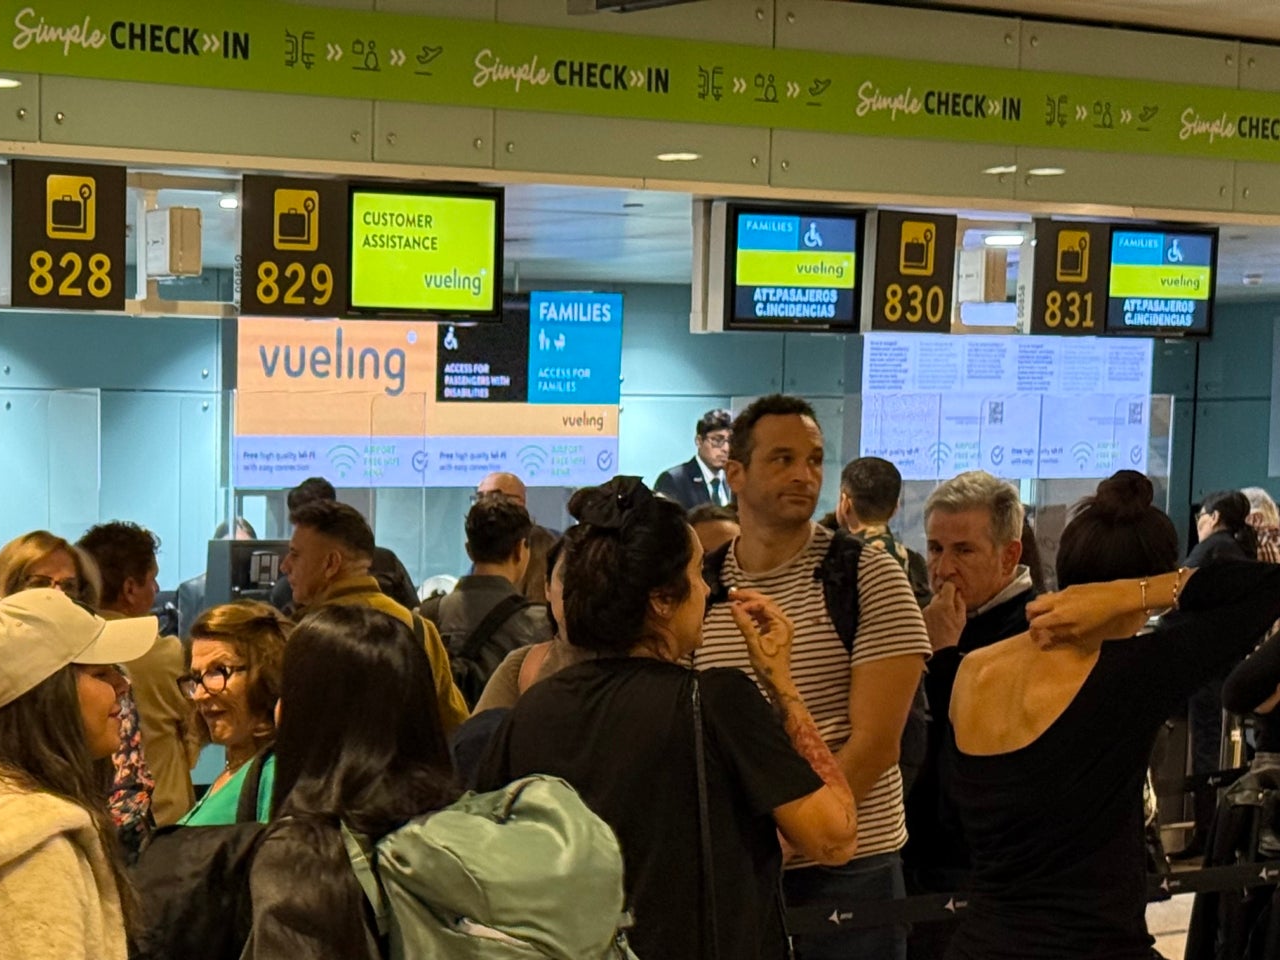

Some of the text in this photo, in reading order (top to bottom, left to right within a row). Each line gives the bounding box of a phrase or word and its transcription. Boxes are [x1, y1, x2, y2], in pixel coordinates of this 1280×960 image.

[12, 7, 107, 56] Simple
[109, 20, 200, 56] CHECK
[473, 48, 551, 92] Simple
[553, 59, 628, 91] CHECK
[855, 80, 922, 121] Simple
[924, 90, 987, 118] CHECK
[1179, 106, 1280, 144] Simple CHEC
[362, 209, 433, 229] CUSTOMER
[746, 220, 793, 232] FAMILIES
[362, 232, 438, 252] ASSISTANCE
[28, 249, 112, 298] 828
[256, 260, 333, 305] 829
[423, 266, 483, 296] vueling
[796, 261, 844, 279] vueling
[1160, 274, 1200, 291] vueling
[539, 301, 612, 323] FAMILIES
[883, 283, 944, 324] 830
[1044, 290, 1095, 328] 831
[258, 327, 407, 397] vueling
[538, 368, 591, 378] ACCESS FOR
[538, 381, 577, 393] FAMILIES
[562, 410, 605, 430] vueling
